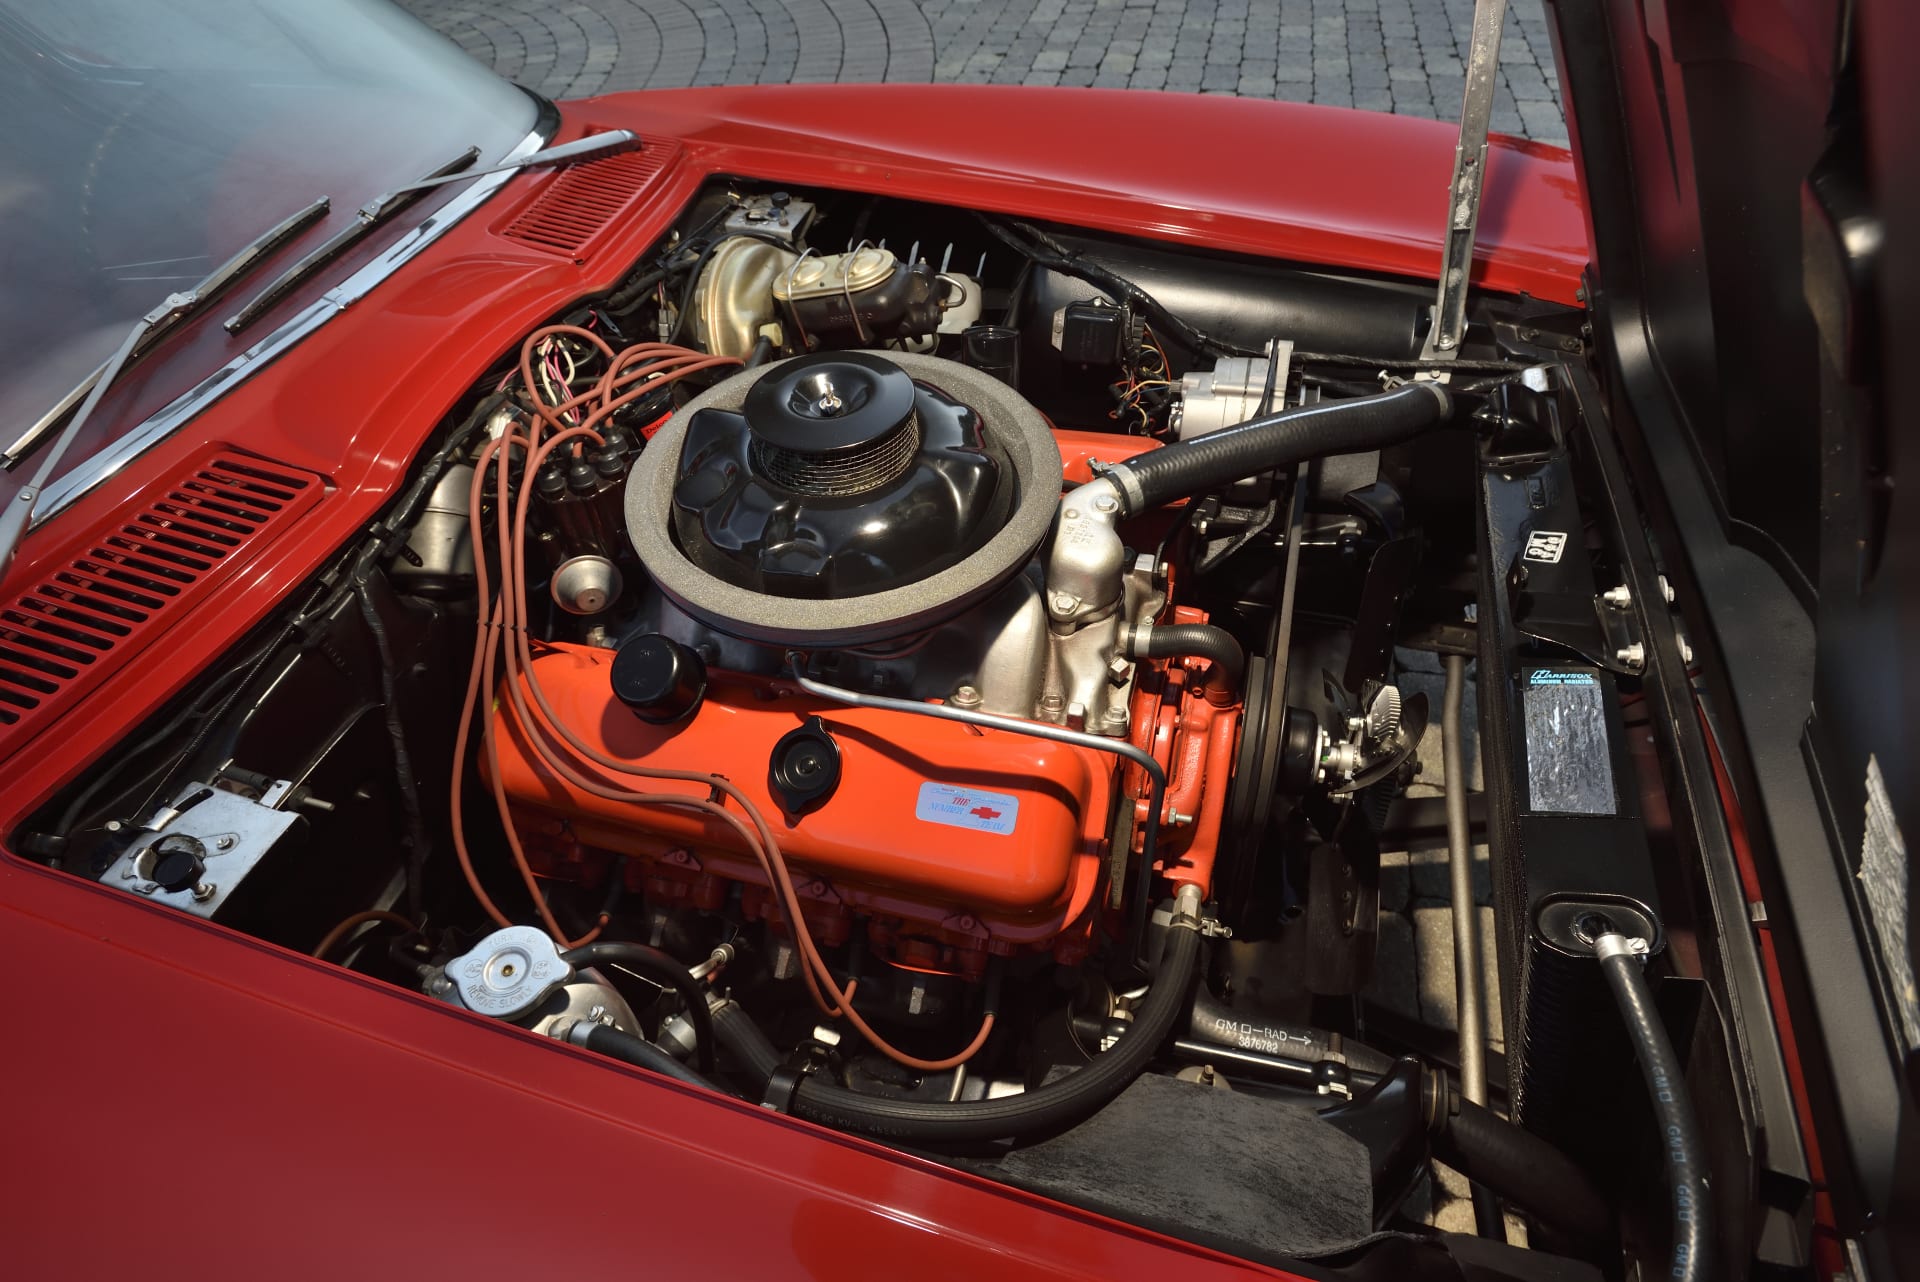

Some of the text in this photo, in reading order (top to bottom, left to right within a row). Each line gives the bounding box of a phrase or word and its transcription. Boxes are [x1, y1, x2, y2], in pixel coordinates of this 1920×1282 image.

[1530, 669, 1593, 680] HARRISON
[467, 984, 533, 1009] REMOVE SLOWLY
[1215, 1019, 1237, 1032] GM
[1238, 1036, 1279, 1054] 3876782
[1667, 1125, 1682, 1148] GM
